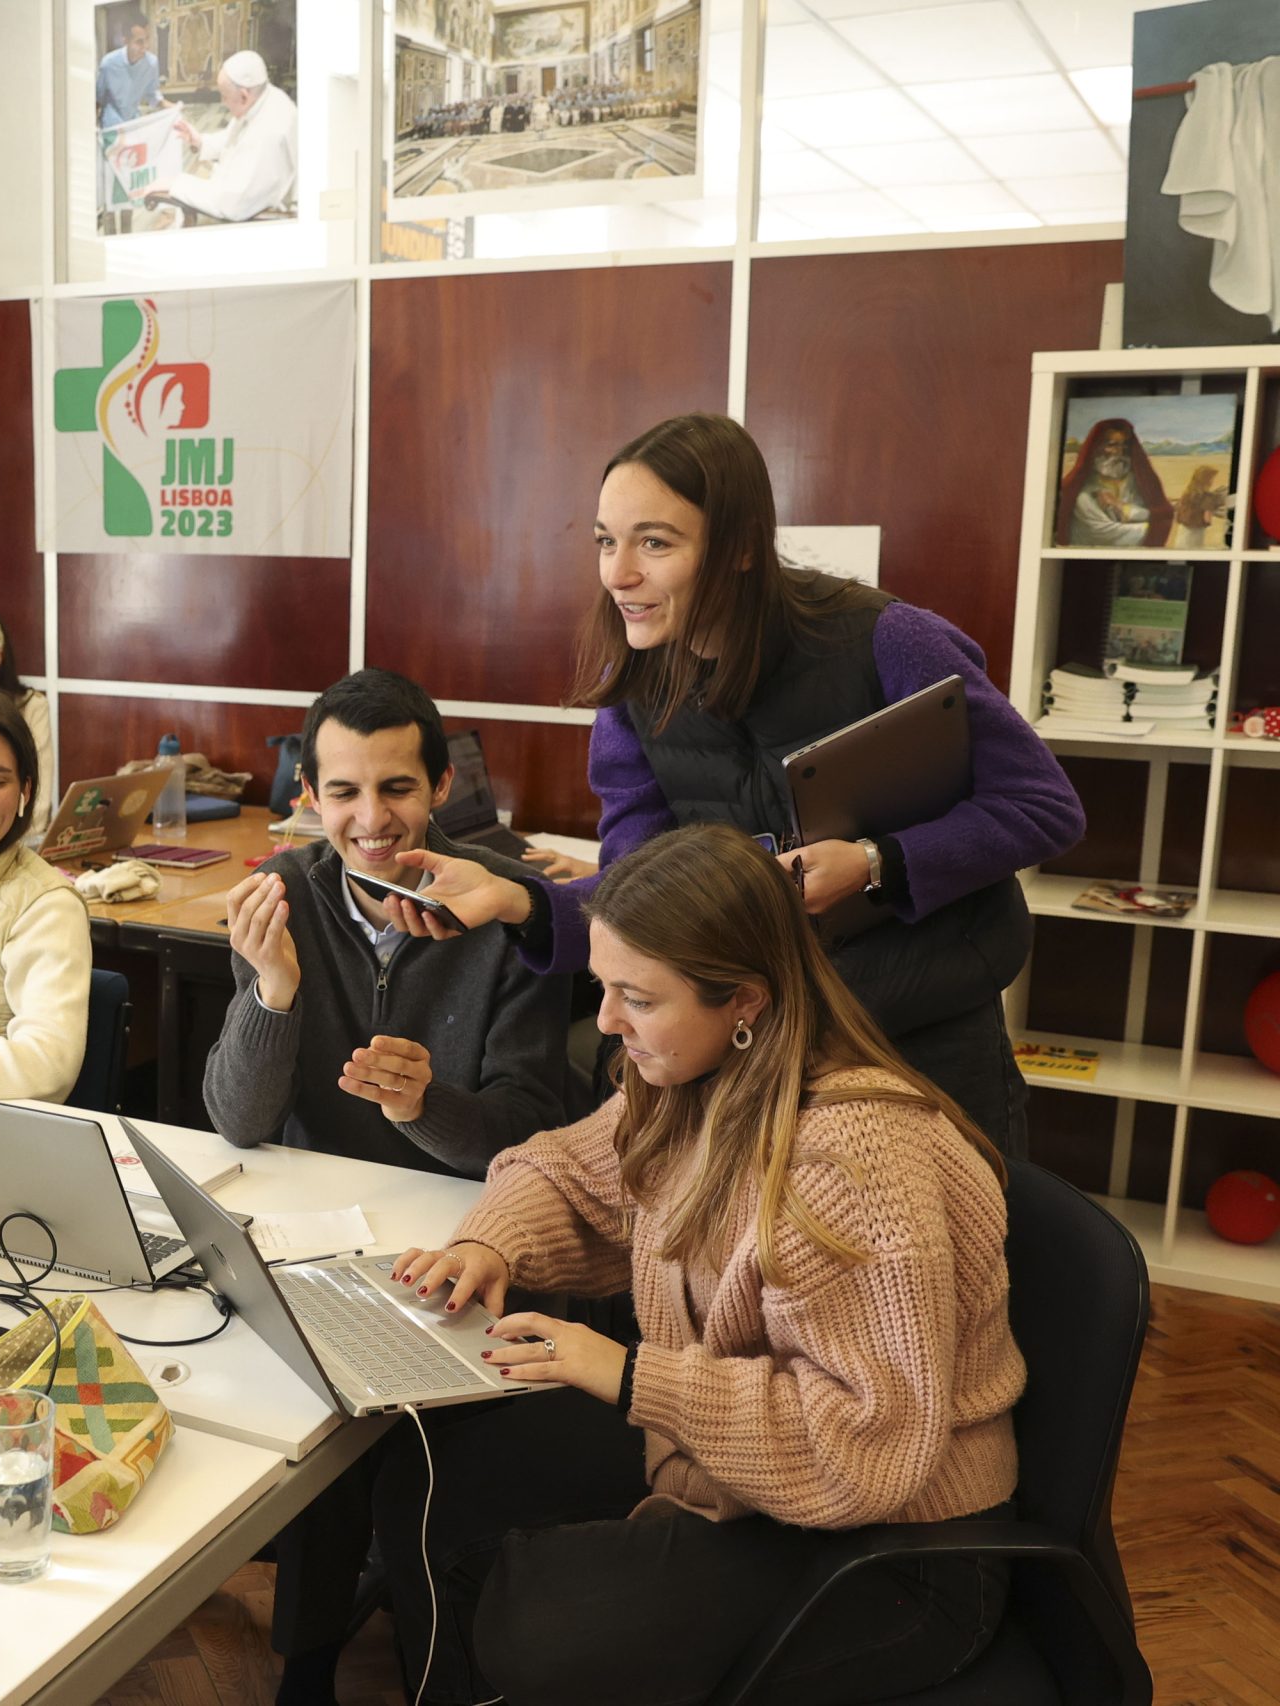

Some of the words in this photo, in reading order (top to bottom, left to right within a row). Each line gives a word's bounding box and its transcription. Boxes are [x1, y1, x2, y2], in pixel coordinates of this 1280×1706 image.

[161, 438, 234, 486] JMJ
[160, 488, 233, 507] LISBOA
[160, 509, 233, 537] 2023
